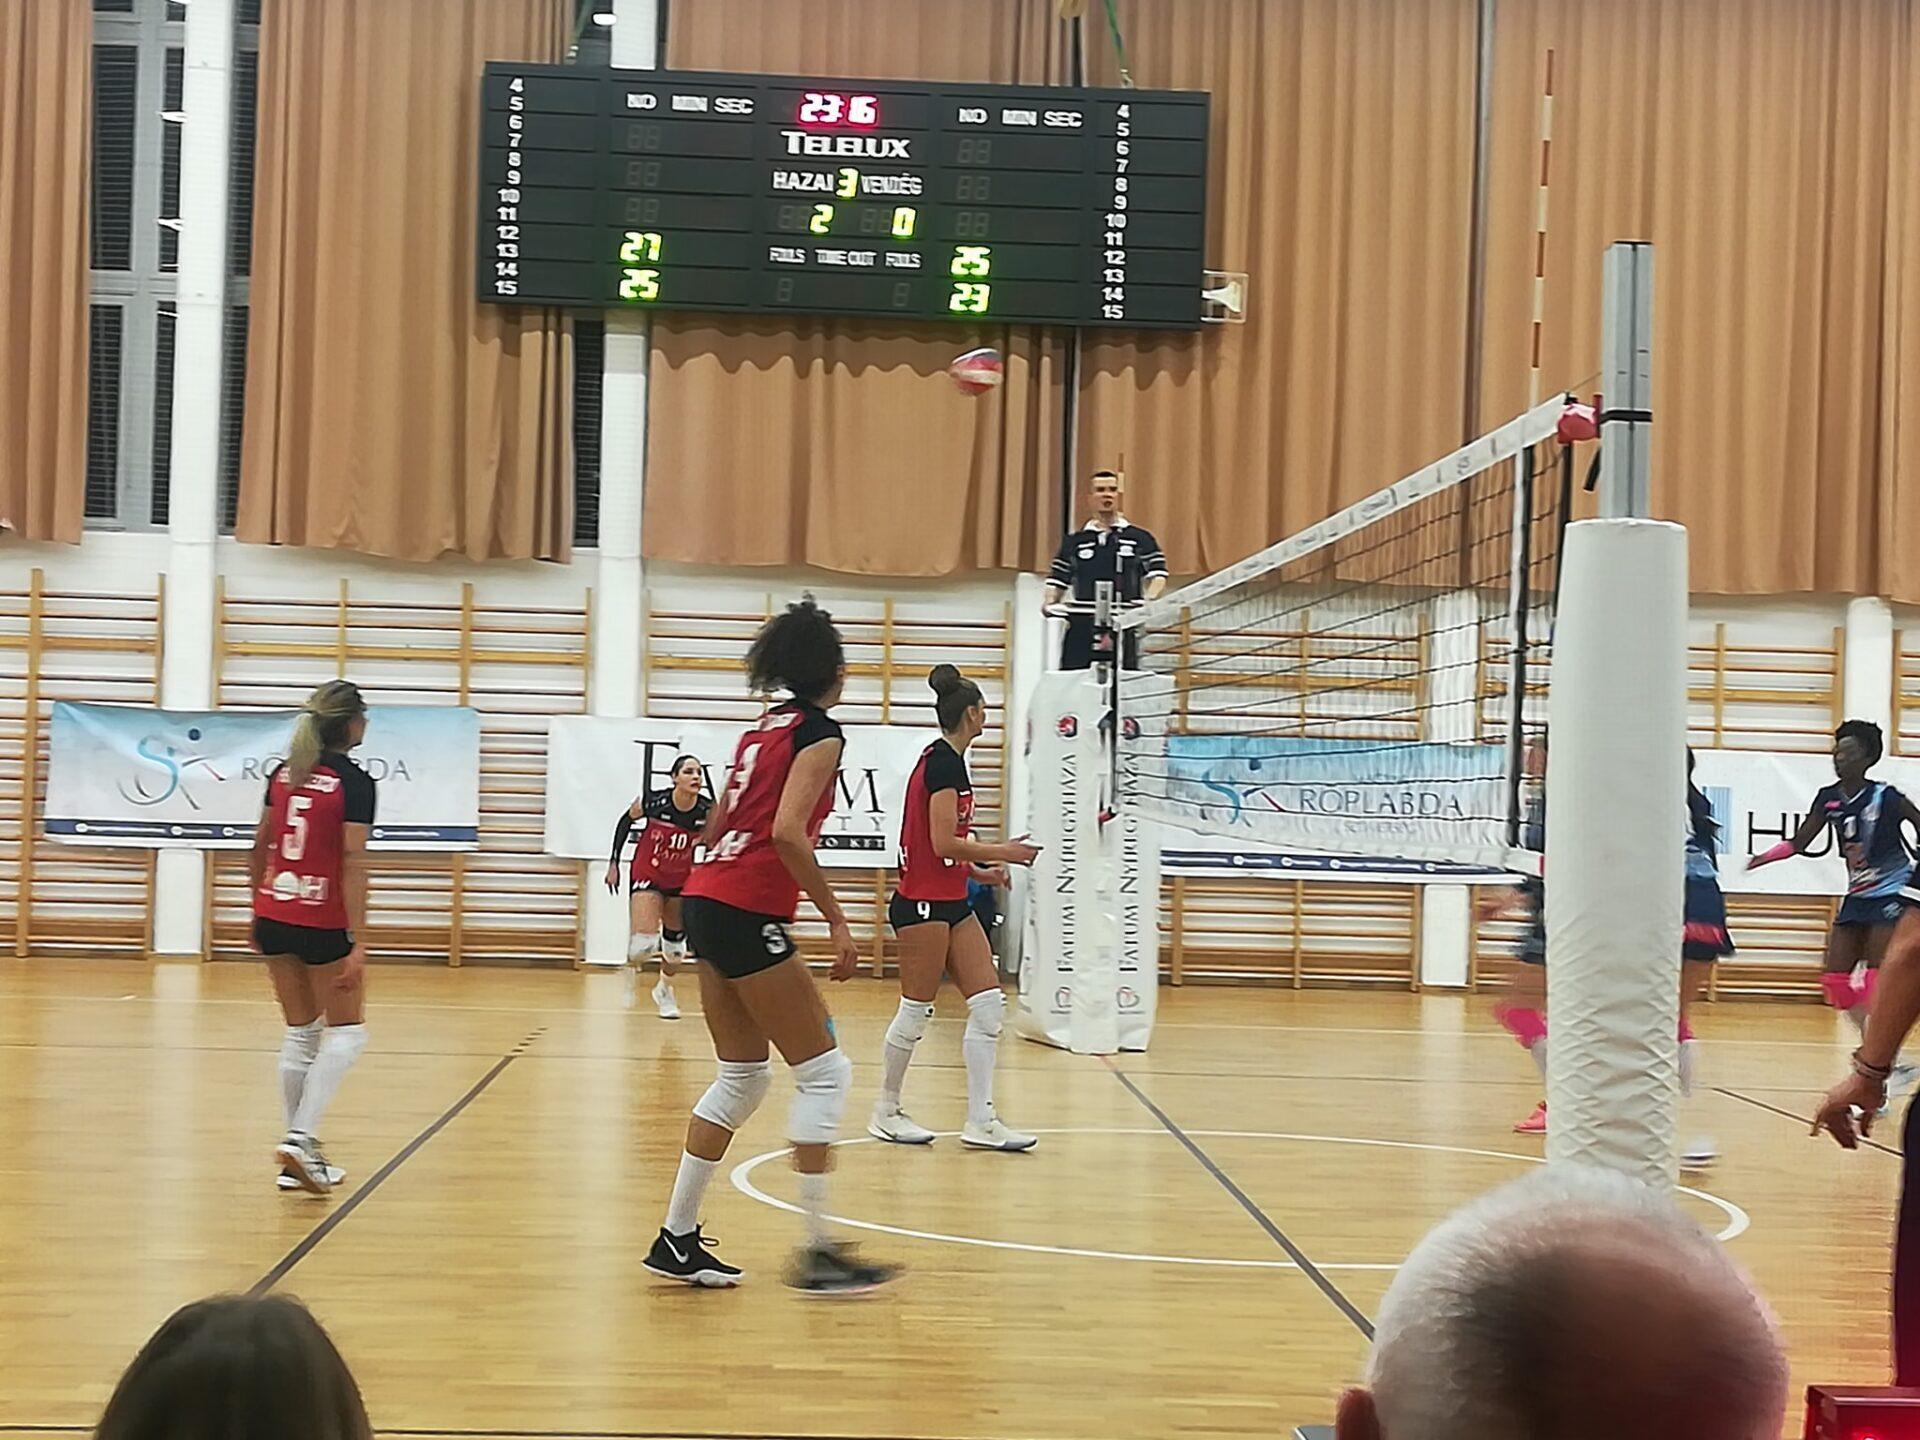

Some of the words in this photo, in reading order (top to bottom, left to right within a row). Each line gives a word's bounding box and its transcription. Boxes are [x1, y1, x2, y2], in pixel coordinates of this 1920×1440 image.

[509, 78, 523, 92] 4
[509, 96, 524, 111] 5
[627, 93, 657, 109] NO
[714, 97, 755, 114] SEC
[1117, 104, 1130, 118] 4
[509, 114, 523, 130] 6
[959, 108, 988, 123] NO
[1043, 110, 1083, 127] SEC
[1116, 122, 1130, 137] 5
[508, 132, 522, 147] 7
[1116, 140, 1129, 155] 6
[508, 151, 521, 167] 8
[1115, 158, 1129, 173] 7
[507, 170, 521, 185] 9
[773, 171, 834, 190] HAZAI
[835, 167, 859, 198] 3
[1115, 177, 1128, 192] 8
[497, 188, 520, 204] 10
[1113, 195, 1127, 210] 9
[496, 206, 517, 221] 11
[809, 203, 835, 233] 2
[1104, 213, 1127, 228] 10
[891, 207, 916, 236] 0
[496, 225, 519, 240] 12
[1103, 231, 1123, 246] 11
[496, 243, 518, 258] 13
[1103, 250, 1126, 265] 12
[950, 246, 991, 276] 25
[495, 262, 518, 277] 14
[1103, 269, 1125, 283] 13
[494, 280, 518, 295] 15
[619, 268, 660, 299] 25
[1101, 287, 1125, 301] 14
[1101, 305, 1124, 319] 15
[1300, 787, 1464, 817] ROPLABDA
[281, 795, 313, 861] 5
[668, 833, 688, 850] 10
[917, 901, 931, 920] 9
[1118, 905, 1139, 972] FATUM
